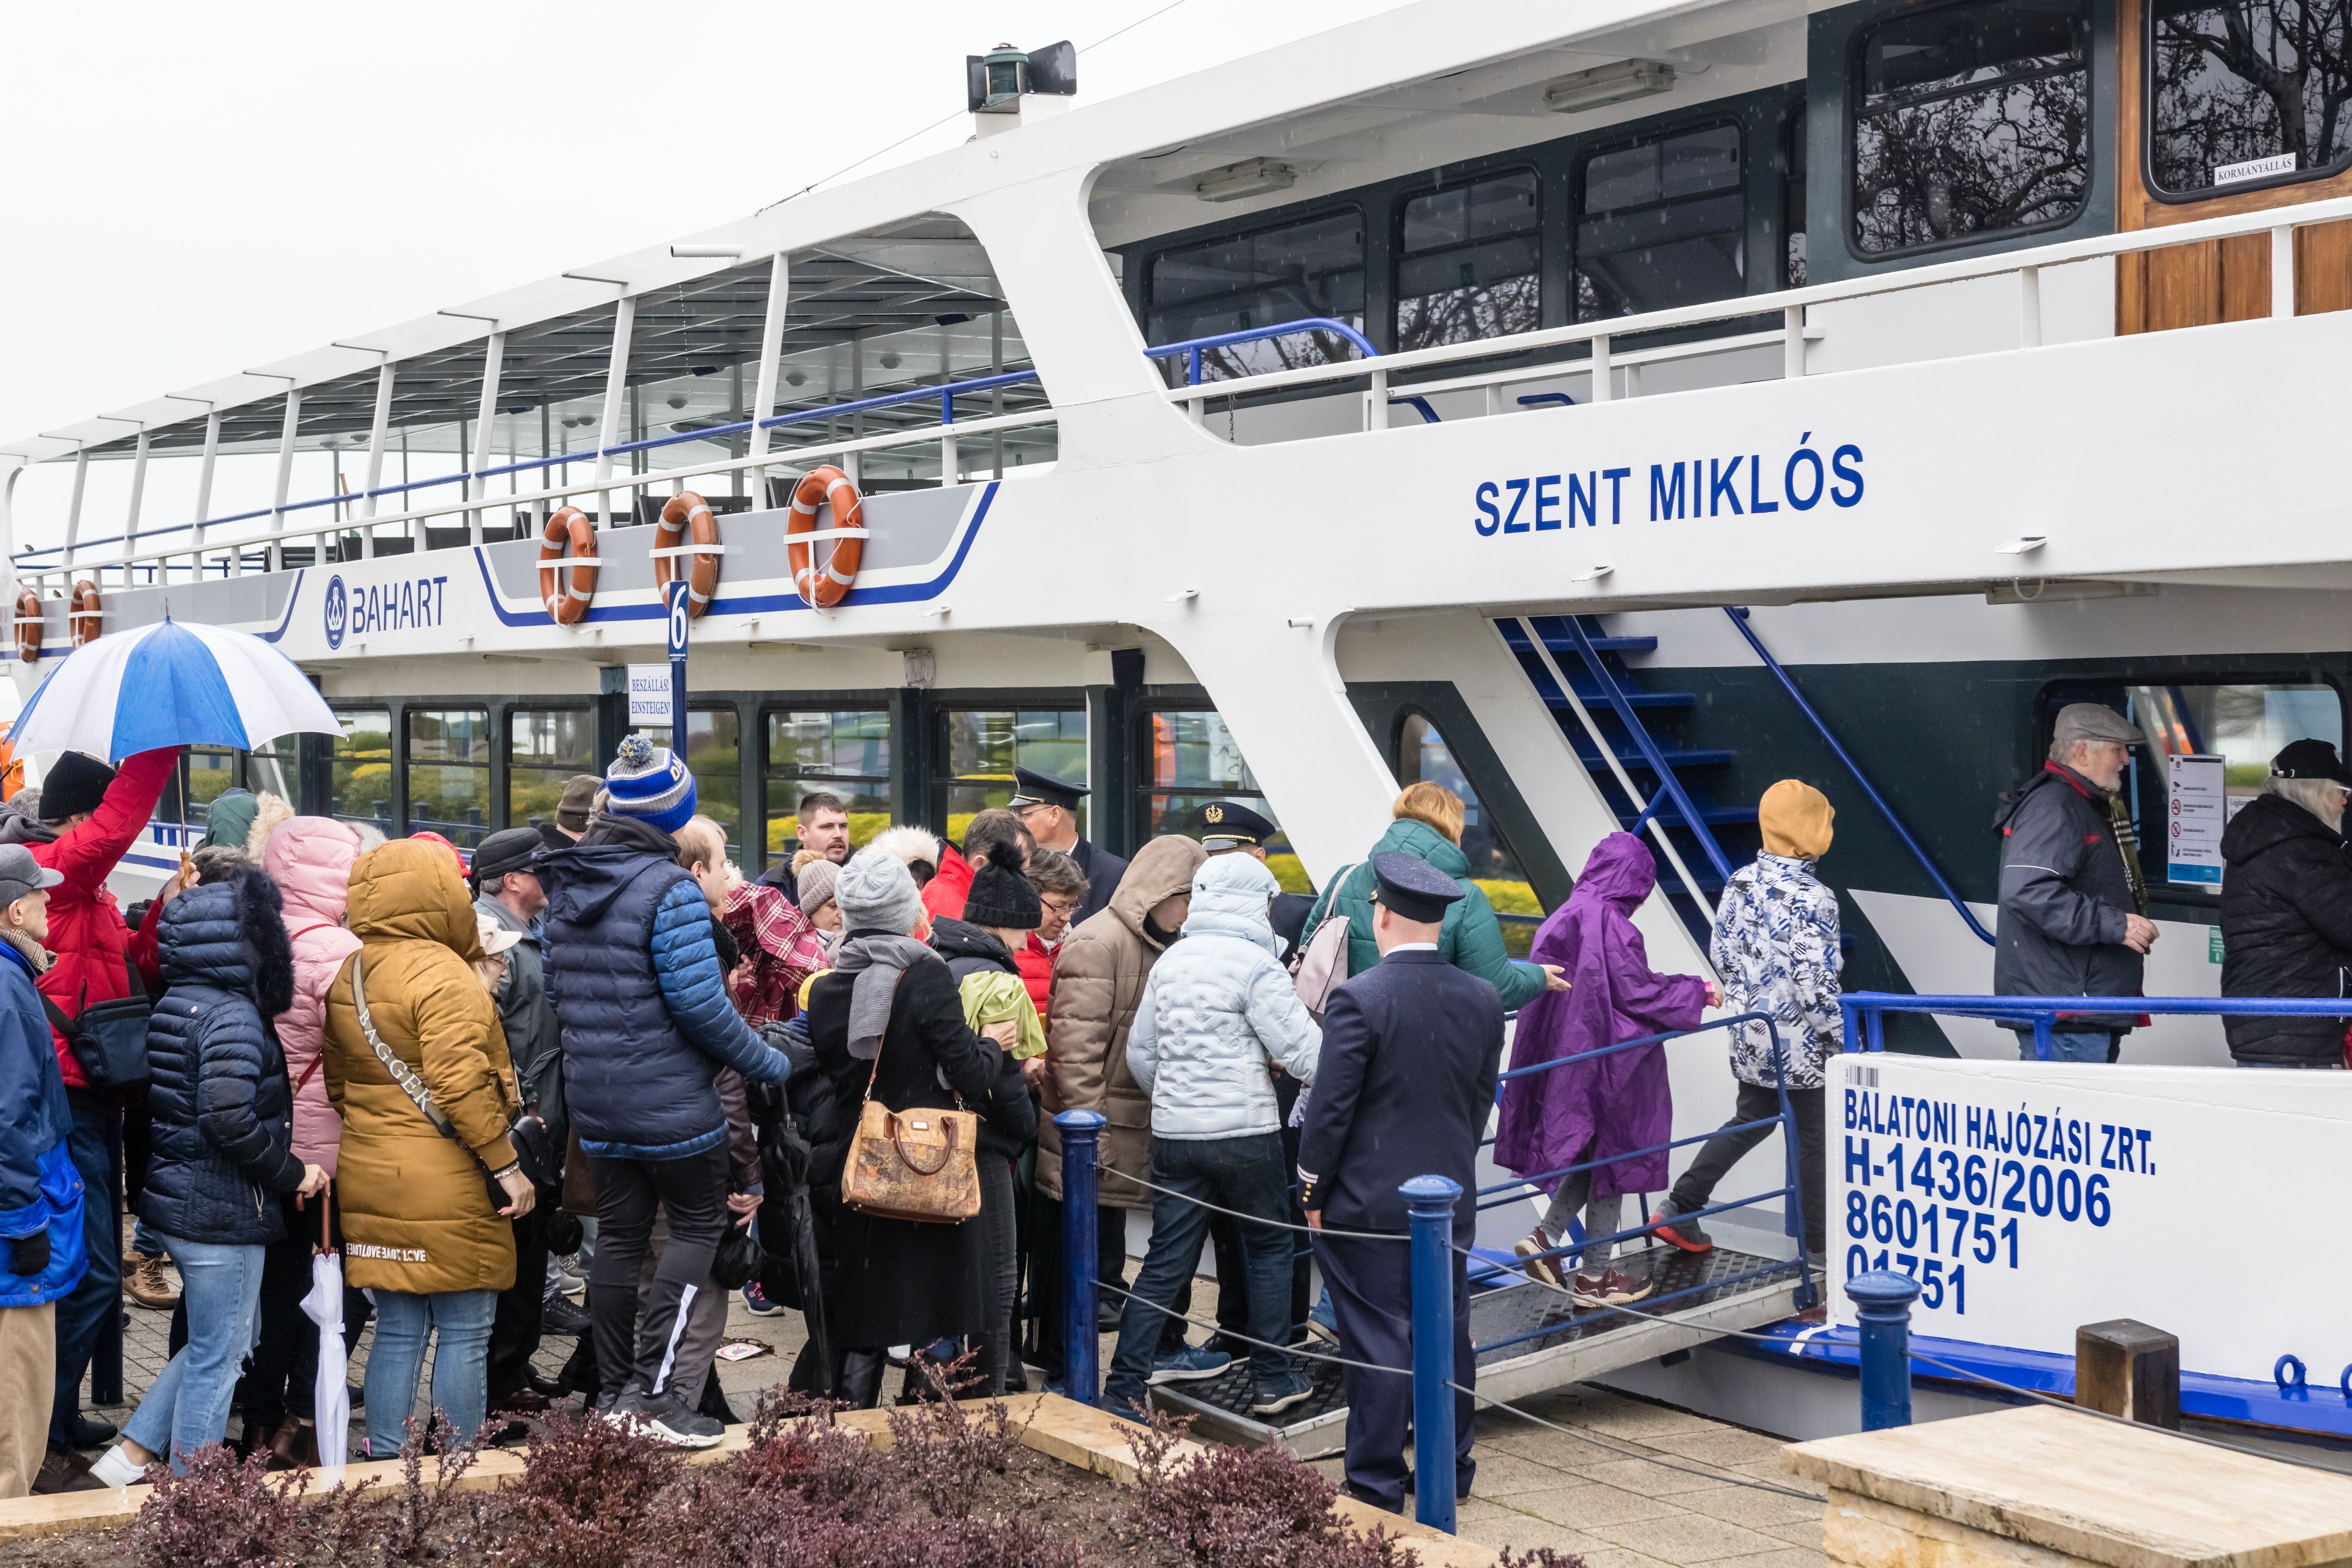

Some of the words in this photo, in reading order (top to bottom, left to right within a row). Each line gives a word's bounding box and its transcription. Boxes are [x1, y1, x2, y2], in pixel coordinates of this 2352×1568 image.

[2218, 158, 2292, 180] KORMÁNYÁLLÁS
[1475, 467, 1631, 537] SZENT
[1650, 432, 1864, 522] MIKLÓS
[353, 576, 447, 634] BAHART
[671, 584, 686, 649] 6
[632, 675, 669, 691] BESZÁLLÁS!
[632, 702, 670, 714] EINSTEIGEN!
[359, 1007, 432, 1112] BAGGER
[1845, 1089, 1956, 1145] BALATONI
[1967, 1102, 2091, 1166] HAJÓZÁSI
[2101, 1124, 2156, 1176] ZRT.
[1845, 1135, 2111, 1227] H-1436/2006
[361, 1245, 381, 1258] LOVE
[403, 1249, 426, 1262] LOVE
[1846, 1190, 2018, 1269] 8601751
